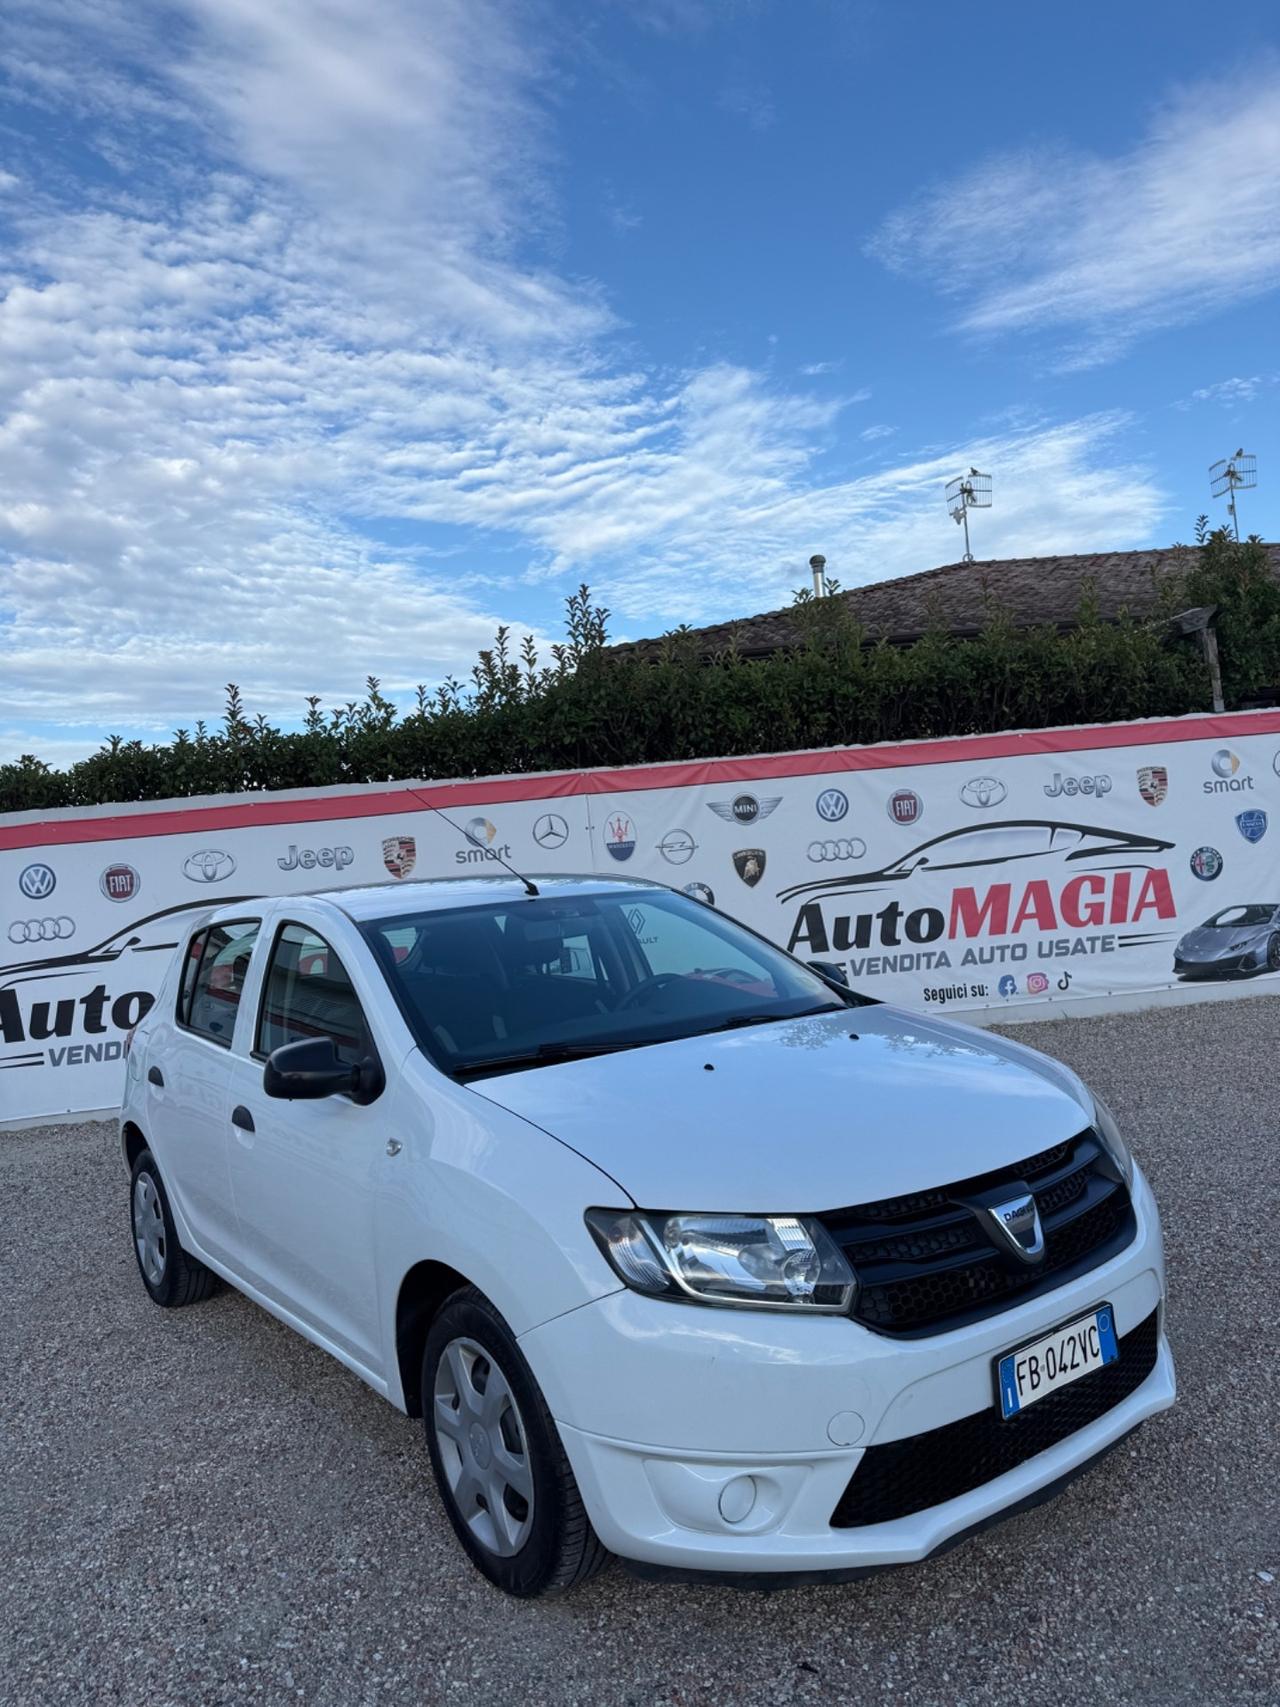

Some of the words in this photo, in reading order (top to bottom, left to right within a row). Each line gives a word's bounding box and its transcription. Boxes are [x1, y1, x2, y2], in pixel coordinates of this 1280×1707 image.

[1043, 773, 1113, 798] Jeep
[1203, 776, 1254, 794] smart
[734, 803, 758, 814] MINI
[895, 799, 915, 817] FIAT
[277, 845, 355, 871] Jeep
[455, 844, 512, 864] smart
[109, 874, 132, 893] FIAT
[849, 950, 952, 977] VENDITA
[961, 942, 1028, 966] AUTO
[1037, 934, 1116, 959] USATE
[923, 983, 968, 1004] Seguici
[971, 985, 989, 997] su:
